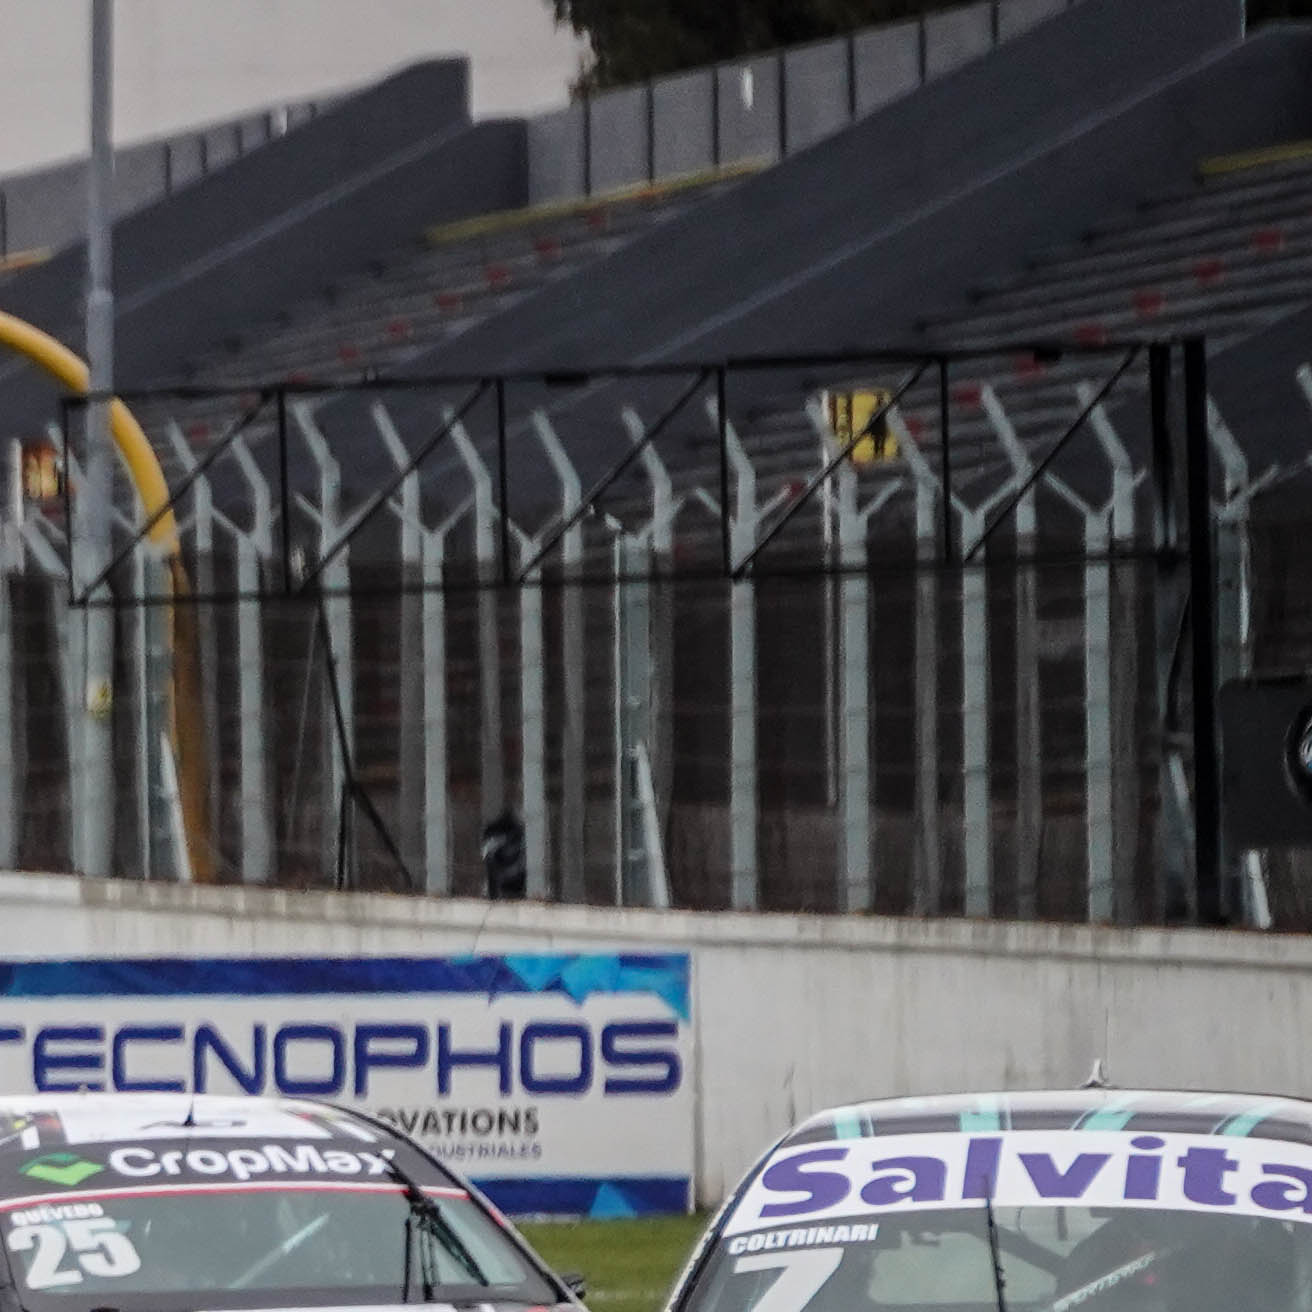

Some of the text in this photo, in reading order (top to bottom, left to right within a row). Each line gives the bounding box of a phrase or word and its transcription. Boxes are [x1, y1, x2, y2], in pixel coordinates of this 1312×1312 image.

[378, 1104, 540, 1137] OVATIONS
[108, 1144, 397, 1181] CropMax
[6, 1216, 142, 1291] 25
[728, 1223, 880, 1255] COLTRINARI
